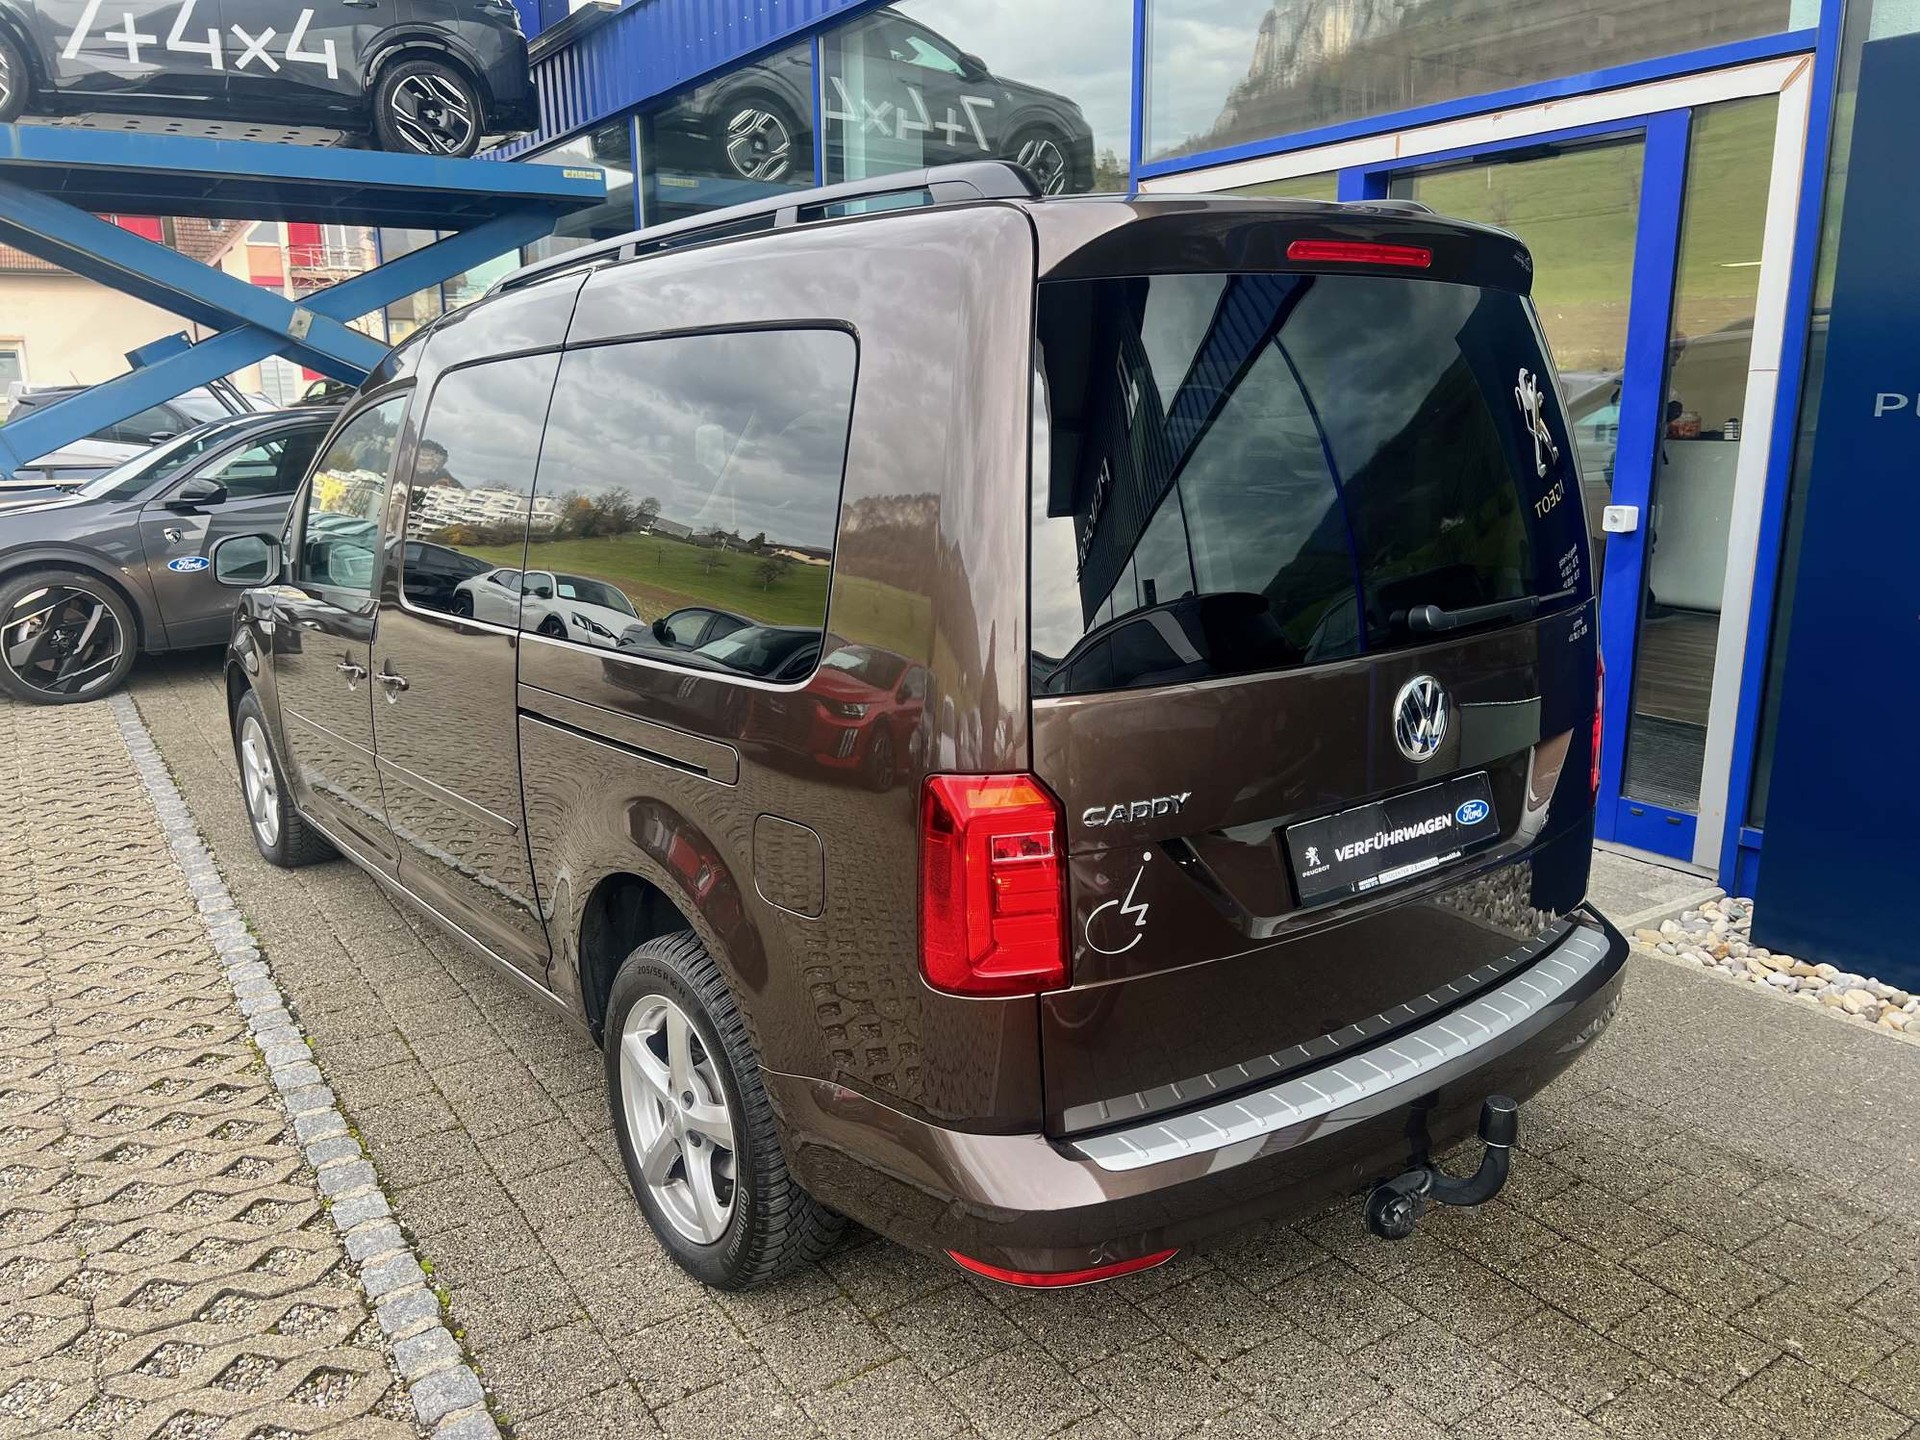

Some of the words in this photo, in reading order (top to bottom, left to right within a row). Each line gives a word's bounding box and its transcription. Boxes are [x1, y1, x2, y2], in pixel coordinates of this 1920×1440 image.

[1874, 392, 1920, 418] P
[1083, 792, 1192, 827] CADDY
[1334, 813, 1452, 862] VERFÜHRWAGEN
[1302, 864, 1330, 878] PEUGEOT
